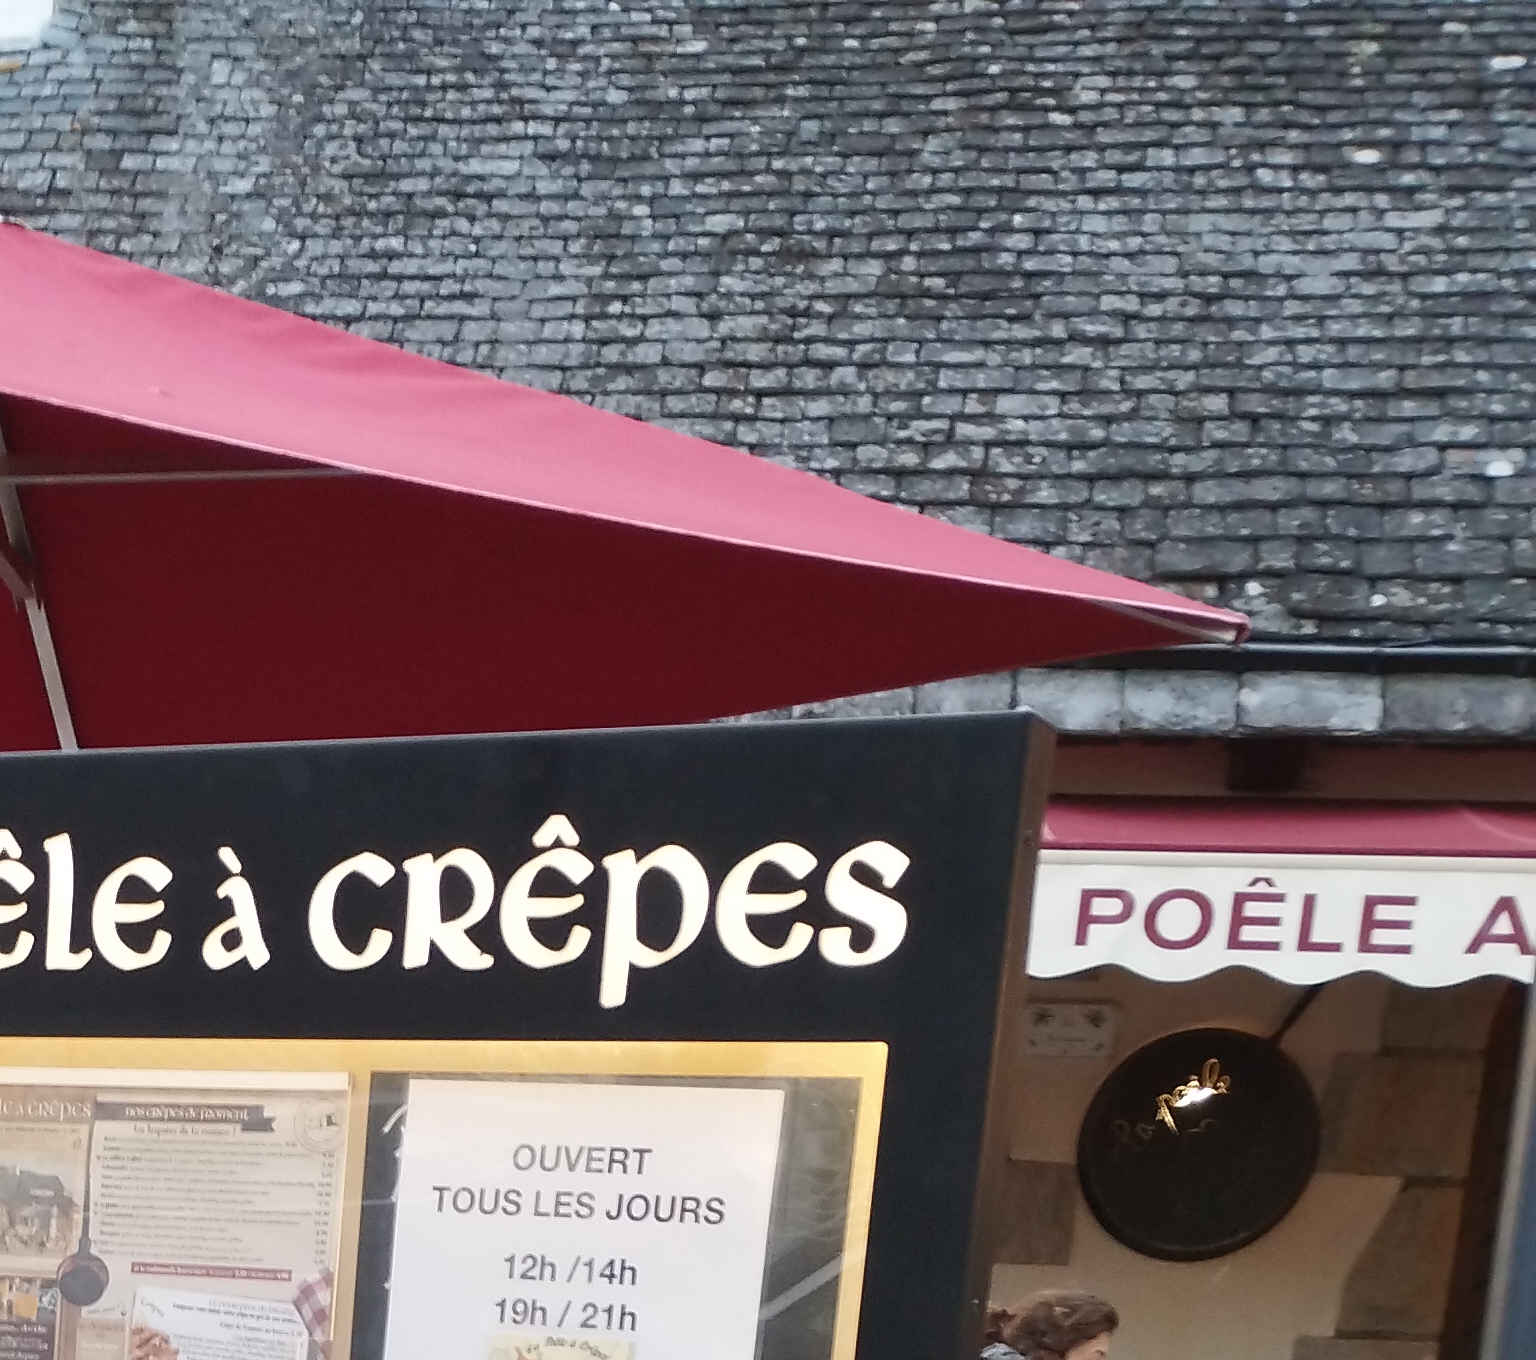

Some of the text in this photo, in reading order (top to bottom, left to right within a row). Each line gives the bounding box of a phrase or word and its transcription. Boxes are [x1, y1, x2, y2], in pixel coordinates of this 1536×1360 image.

[1074, 876, 1536, 955] POÊLE A
[513, 1143, 652, 1176] OUVERT
[432, 1185, 727, 1226] TOUS LES JOURS
[503, 1253, 557, 1284] 12h
[494, 1297, 547, 1327] 19h
[580, 1303, 638, 1333] 21h
